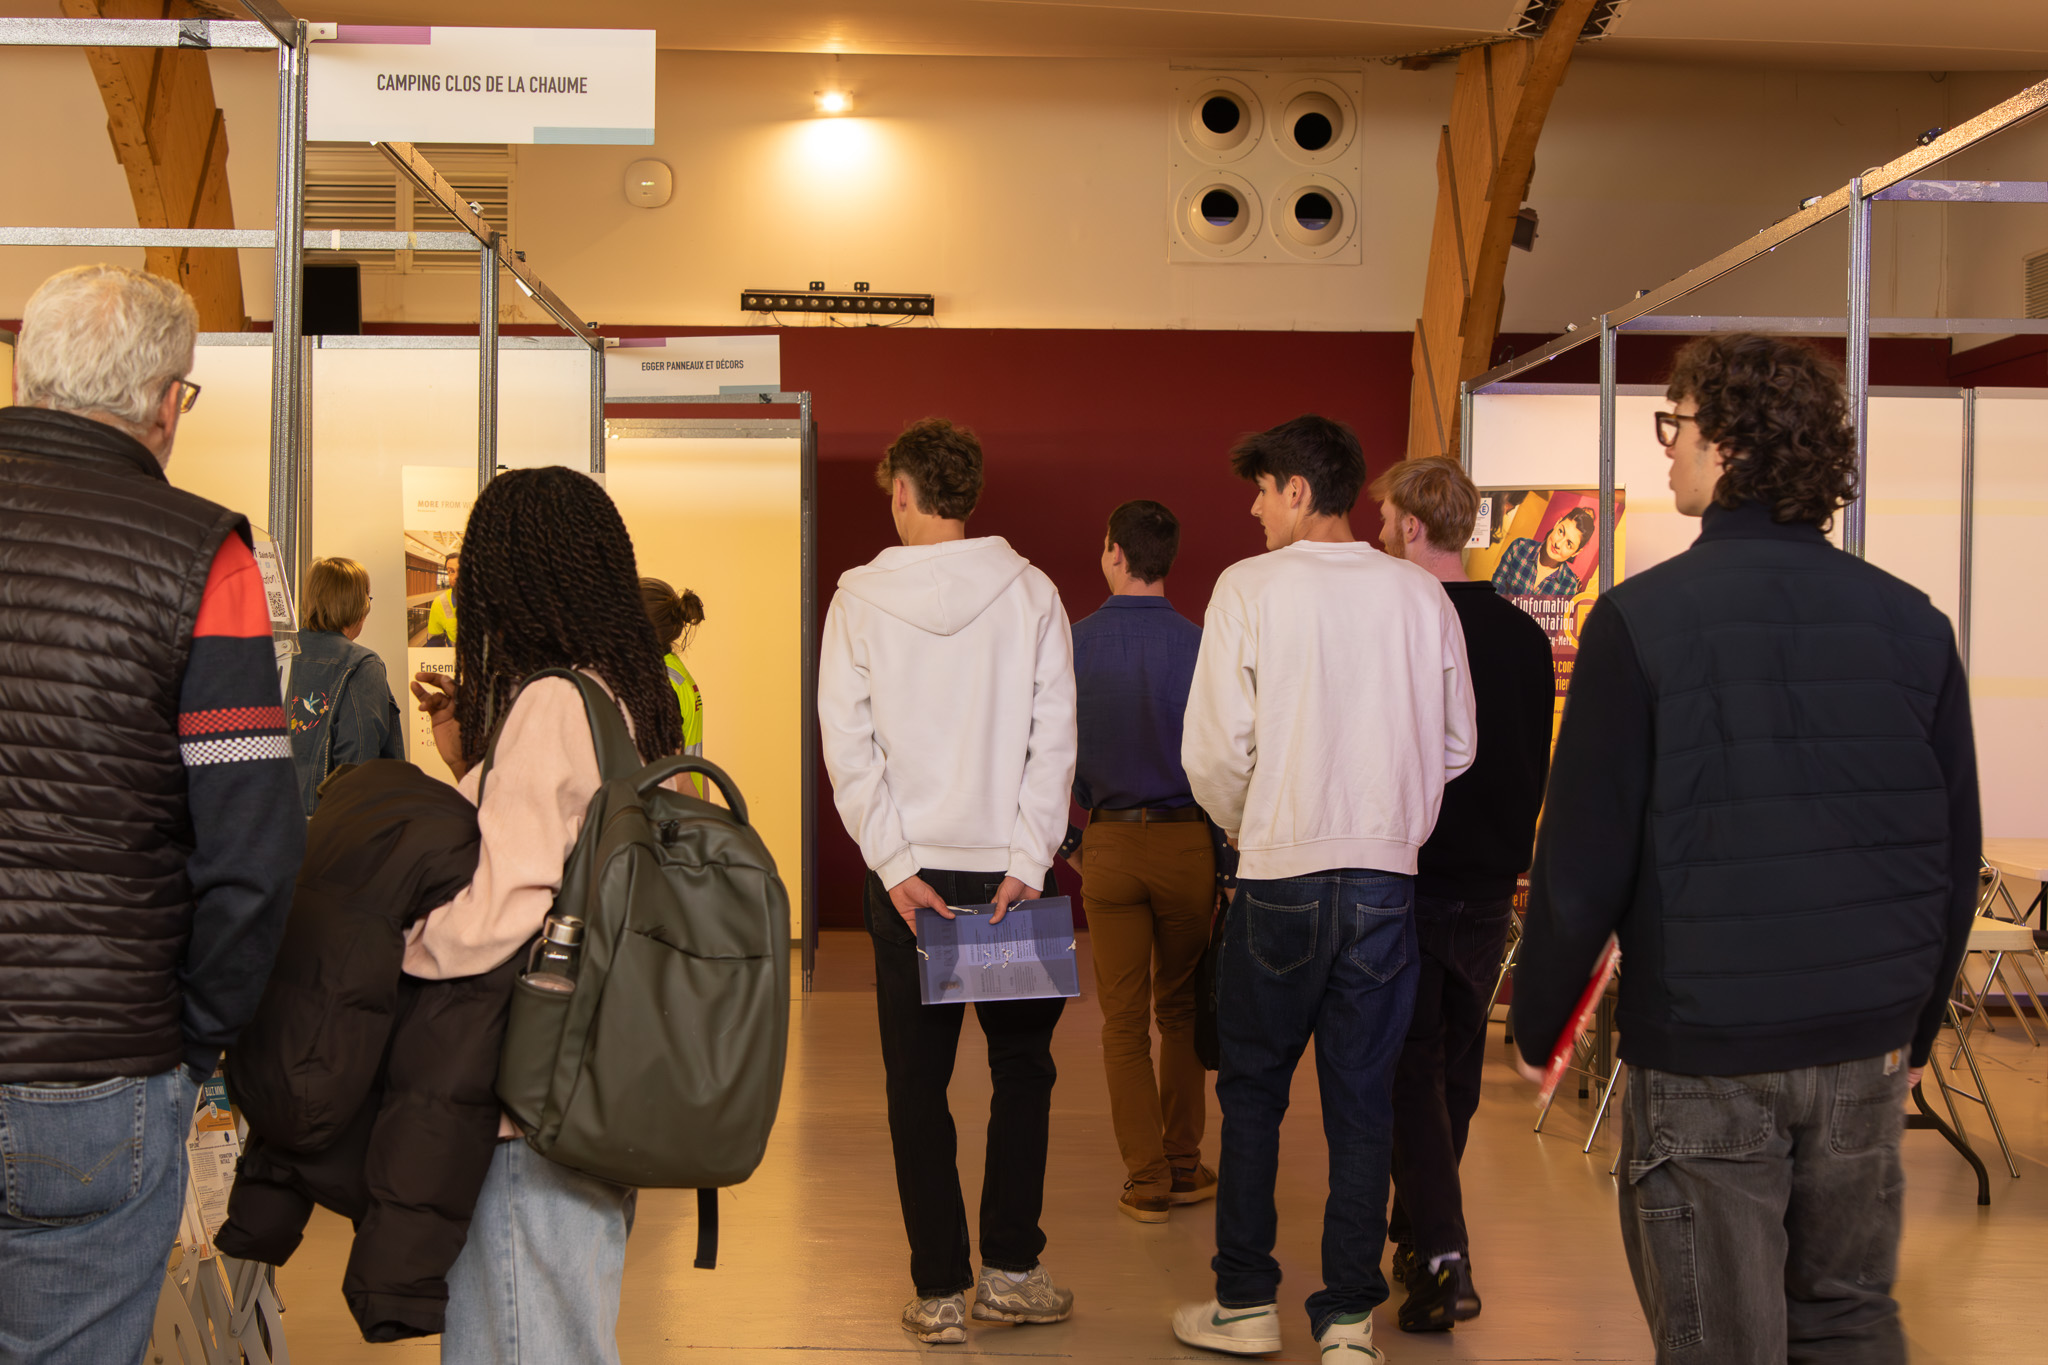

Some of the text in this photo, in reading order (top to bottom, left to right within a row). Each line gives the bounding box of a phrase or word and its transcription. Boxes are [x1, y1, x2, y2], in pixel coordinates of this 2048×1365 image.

[376, 73, 588, 94] CAMPING CLOS DE LA CHAUME
[641, 357, 744, 371] EGGER PANNEAUX ET DÉCORS
[417, 499, 439, 508] MORE
[441, 500, 461, 509] FROM
[1548, 635, 1573, 647] y-Metz
[420, 661, 454, 673] Ensem
